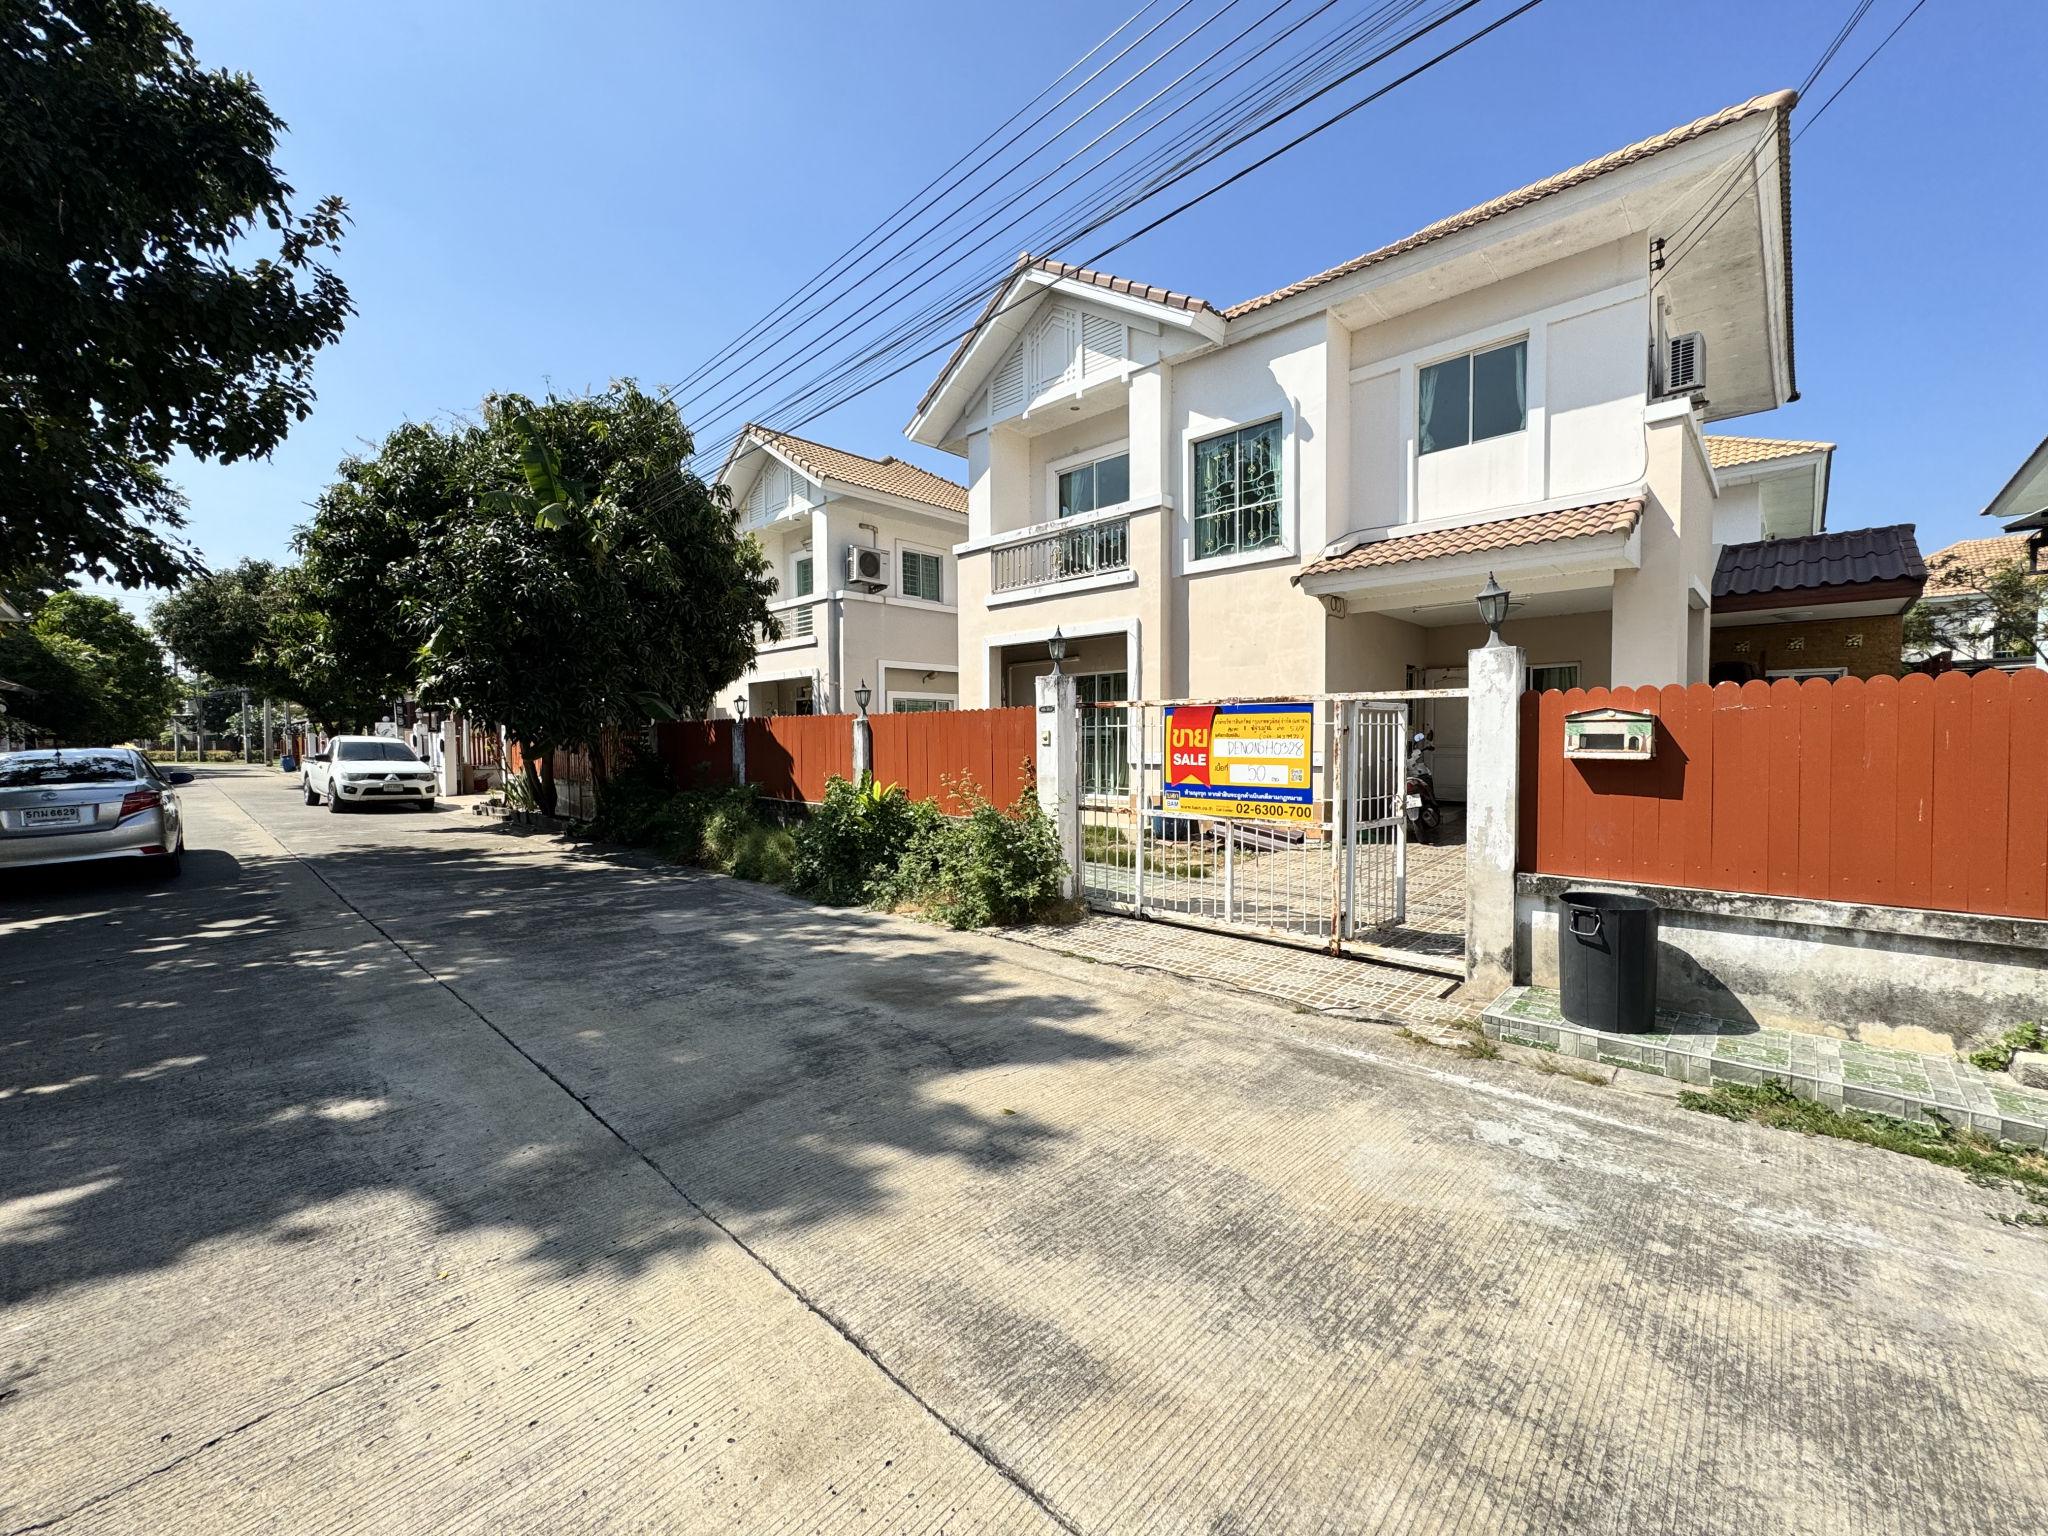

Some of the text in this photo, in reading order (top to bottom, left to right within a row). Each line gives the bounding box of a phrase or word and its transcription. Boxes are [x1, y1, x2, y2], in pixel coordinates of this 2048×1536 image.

[1173, 729, 1208, 748] ขาย
[1173, 753, 1207, 766] SALE
[50, 808, 76, 816] 6629
[1236, 803, 1312, 818] 02-6300-700
